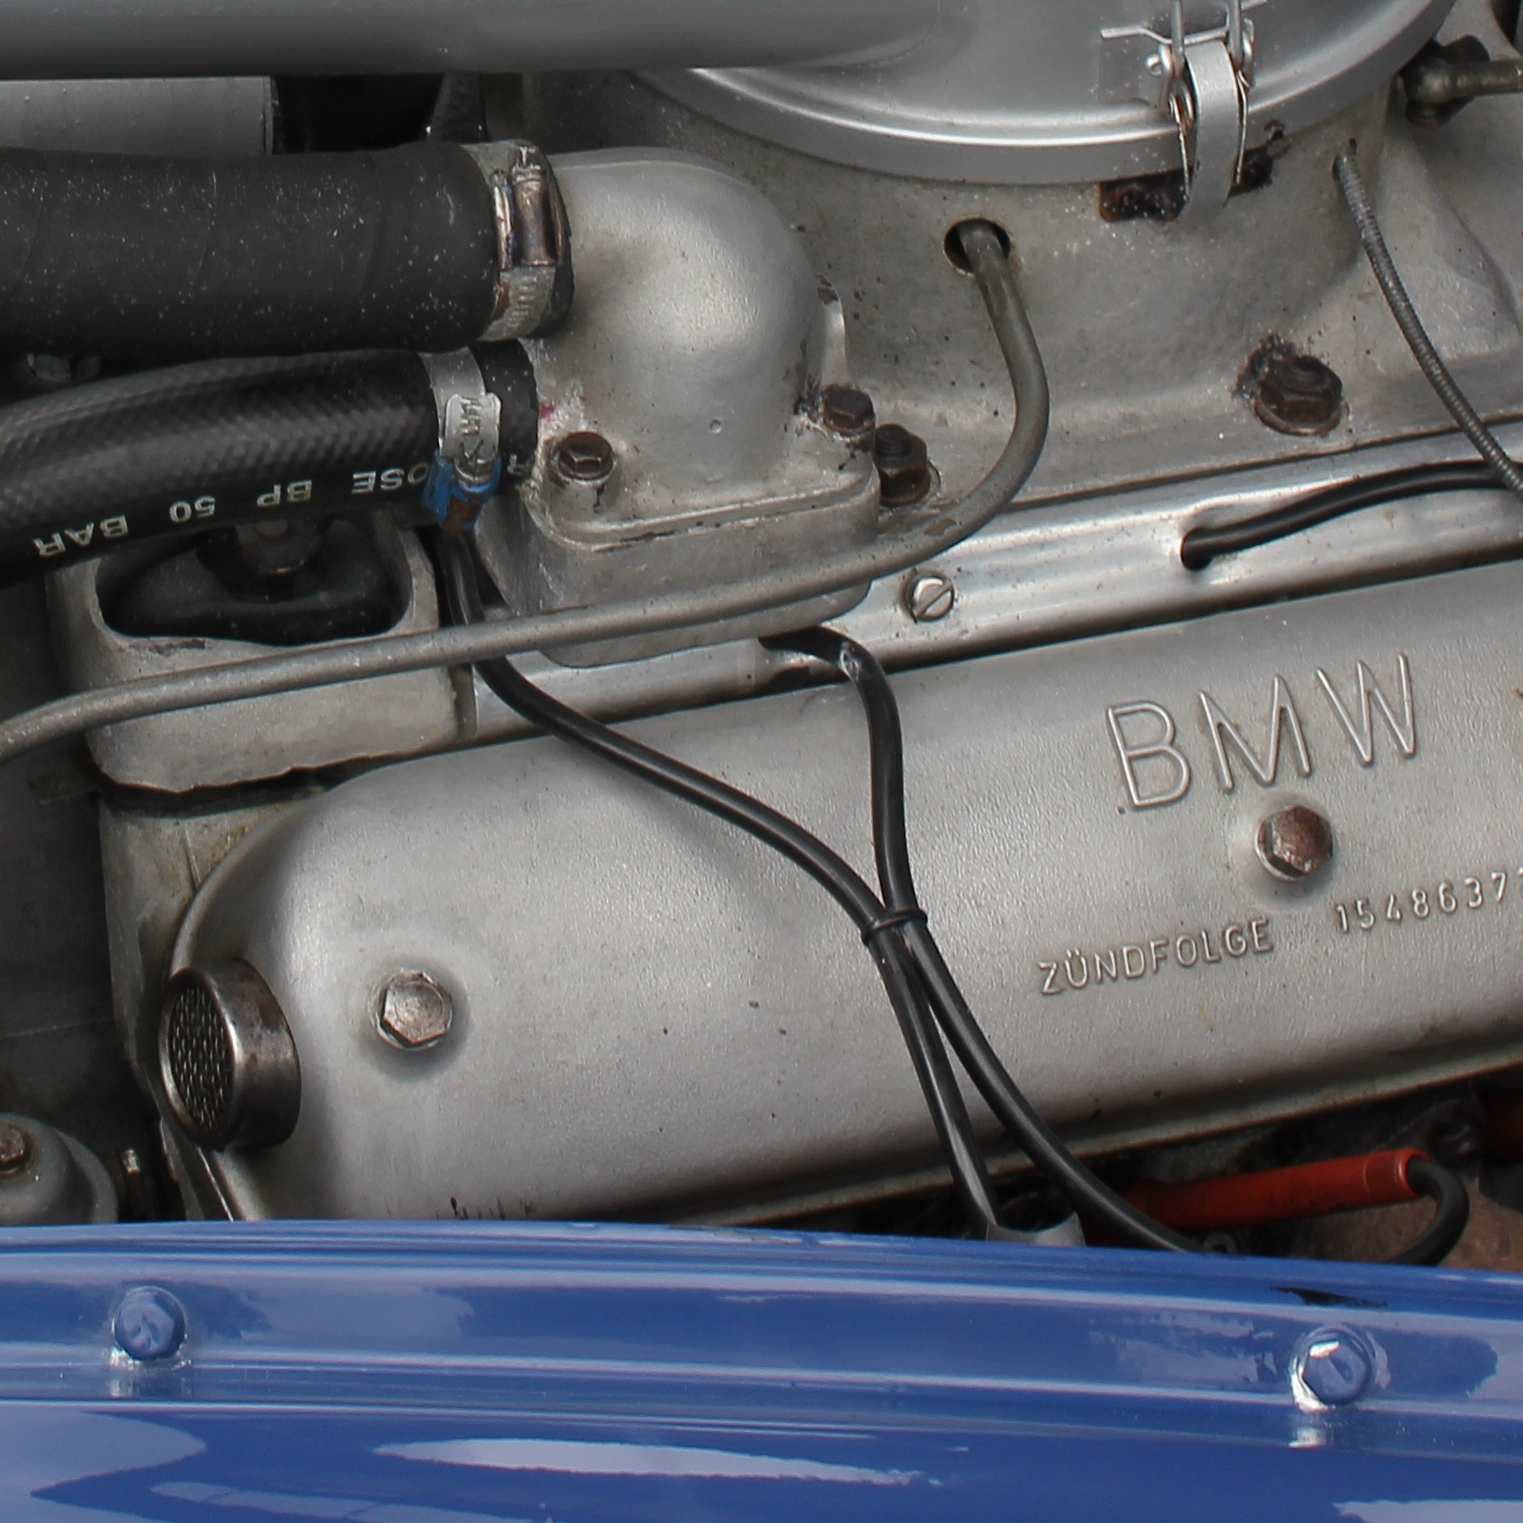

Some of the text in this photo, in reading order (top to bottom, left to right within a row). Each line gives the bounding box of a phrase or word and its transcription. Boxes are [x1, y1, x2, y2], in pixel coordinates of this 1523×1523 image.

[33, 463, 430, 557] OSE BP 50 BAR
[1106, 652, 1417, 811] BMW
[1038, 917, 1275, 997] ZÜNDFOLGE
